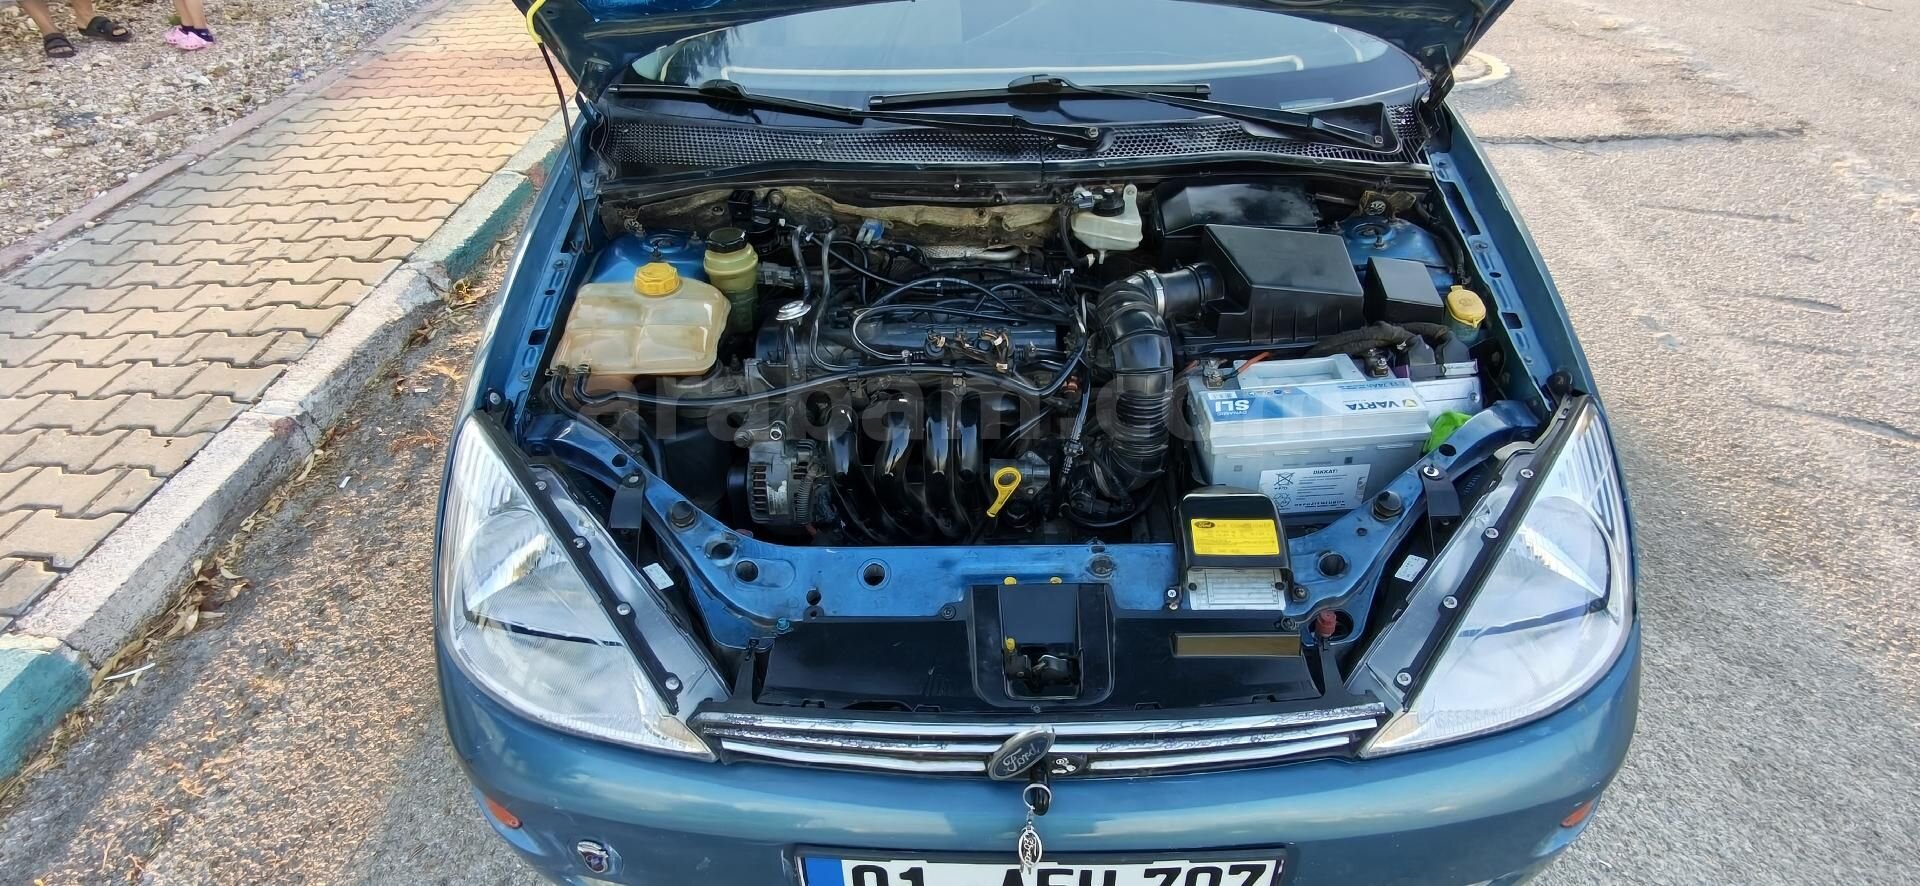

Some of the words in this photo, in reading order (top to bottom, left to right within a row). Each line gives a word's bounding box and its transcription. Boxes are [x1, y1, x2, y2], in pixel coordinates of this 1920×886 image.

[1215, 400, 1249, 413] SLI
[1345, 400, 1400, 411] VARTA
[1002, 743, 1041, 772] Ford
[1022, 833, 1037, 867] Ford
